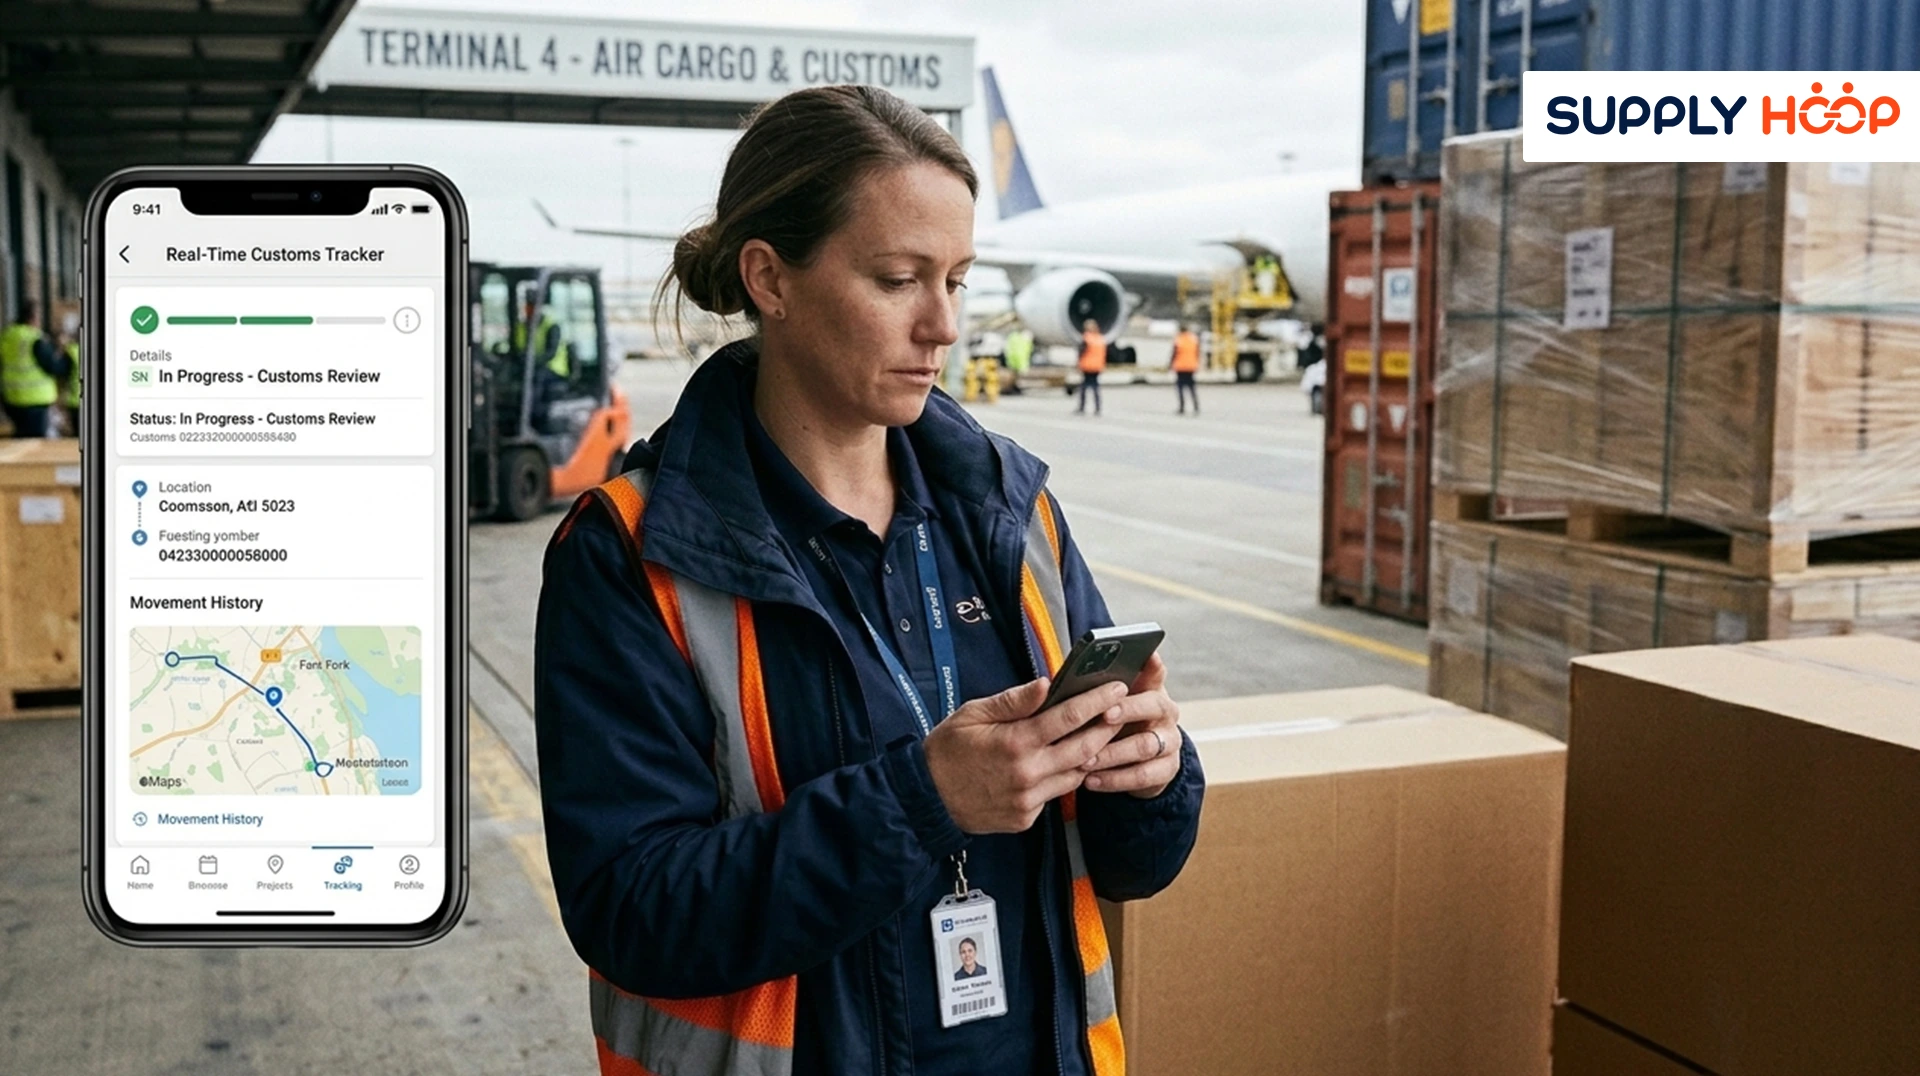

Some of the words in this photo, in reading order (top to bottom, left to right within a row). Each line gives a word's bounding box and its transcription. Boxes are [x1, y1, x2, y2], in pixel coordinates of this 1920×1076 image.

[359, 28, 530, 73] TERMINAL
[540, 35, 558, 73] 4
[593, 39, 644, 76] AIR
[656, 43, 757, 82] CARGO
[769, 47, 790, 84] &
[803, 49, 942, 90] CUSTOMS
[132, 203, 162, 216] 9:41
[166, 246, 247, 262] Real-Time
[250, 246, 321, 262] Customs
[325, 246, 385, 262] Tracker
[129, 349, 173, 362] Details
[131, 370, 149, 383] SN
[158, 369, 173, 383] In
[177, 369, 244, 386] Progress
[257, 369, 323, 384] Customs
[327, 369, 381, 384] Review
[129, 411, 177, 425] Status:
[179, 412, 193, 425] In
[196, 412, 255, 428] Progress
[266, 412, 325, 425] Customs
[328, 412, 376, 425] Review
[129, 431, 177, 443] Customs
[158, 481, 212, 494] Location
[158, 499, 234, 514] Coomsson,
[261, 499, 296, 513] 5023
[158, 529, 211, 544] Fuesting
[213, 530, 260, 544] yomber
[129, 595, 208, 610] Movement
[210, 595, 264, 613] History
[325, 659, 350, 670] Fork
[148, 775, 182, 790] Maps
[157, 813, 219, 825] Movement
[221, 813, 264, 828] History
[323, 880, 363, 892] Tracking
[394, 880, 425, 891] Profile
